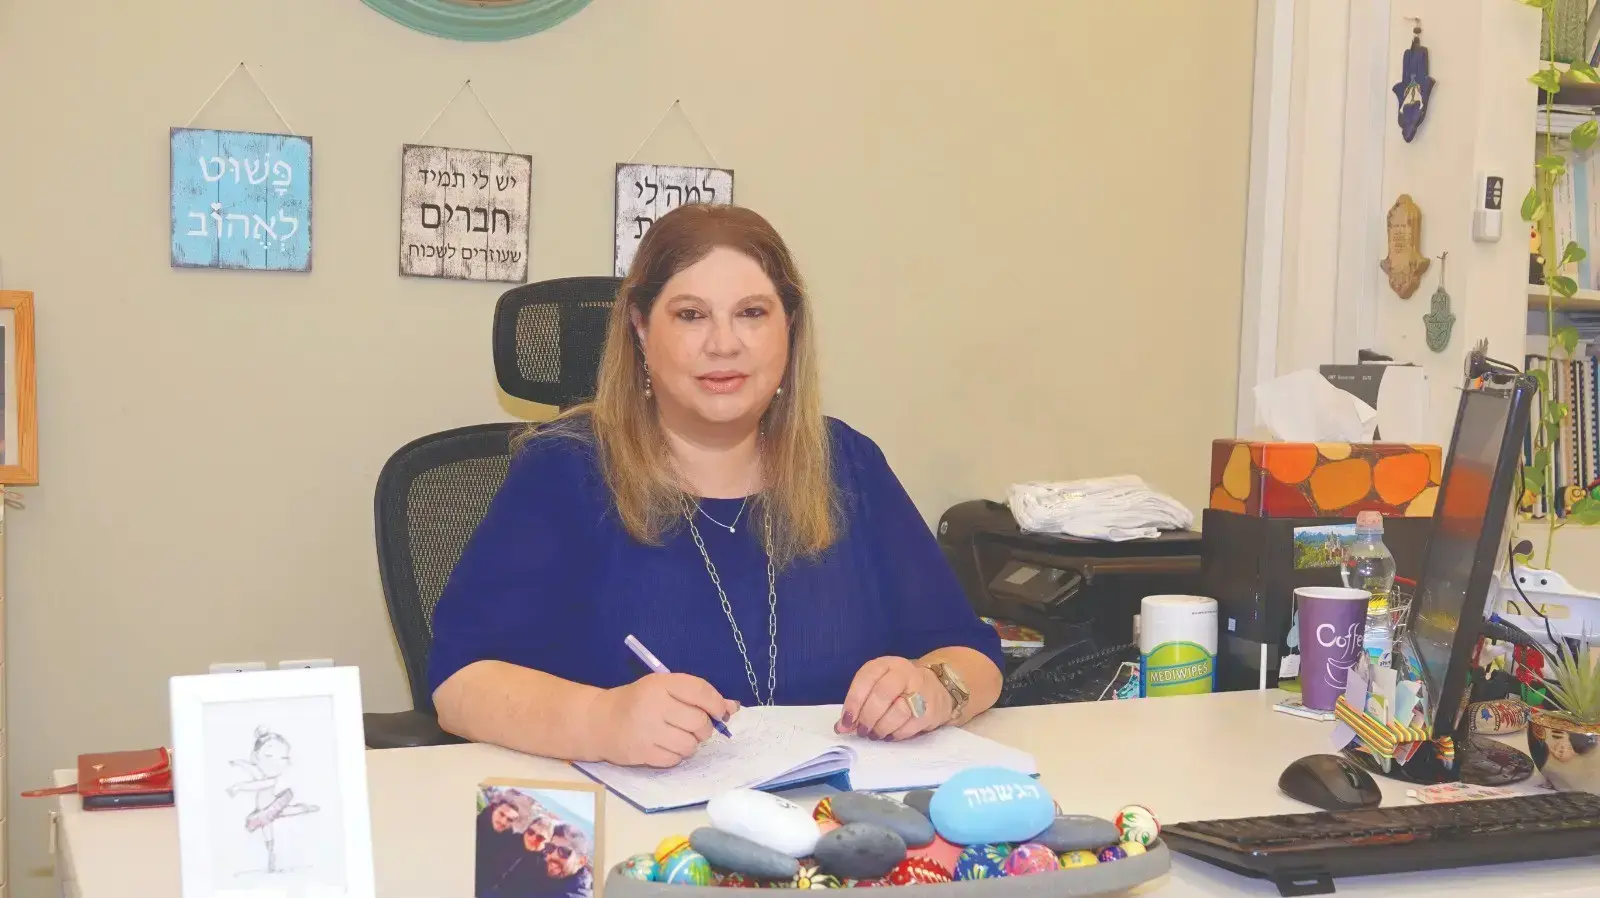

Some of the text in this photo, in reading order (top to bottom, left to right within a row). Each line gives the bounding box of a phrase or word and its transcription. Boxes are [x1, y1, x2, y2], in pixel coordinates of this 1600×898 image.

[418, 169, 517, 192] יש לי תמיד
[635, 176, 716, 207] למה לי
[421, 201, 510, 234] חברים
[409, 243, 522, 263] שעוזרים לשכוח
[1316, 623, 1363, 660] Coffe
[1150, 662, 1208, 682] MEDIWIPES
[963, 783, 1040, 808] הגשמה
